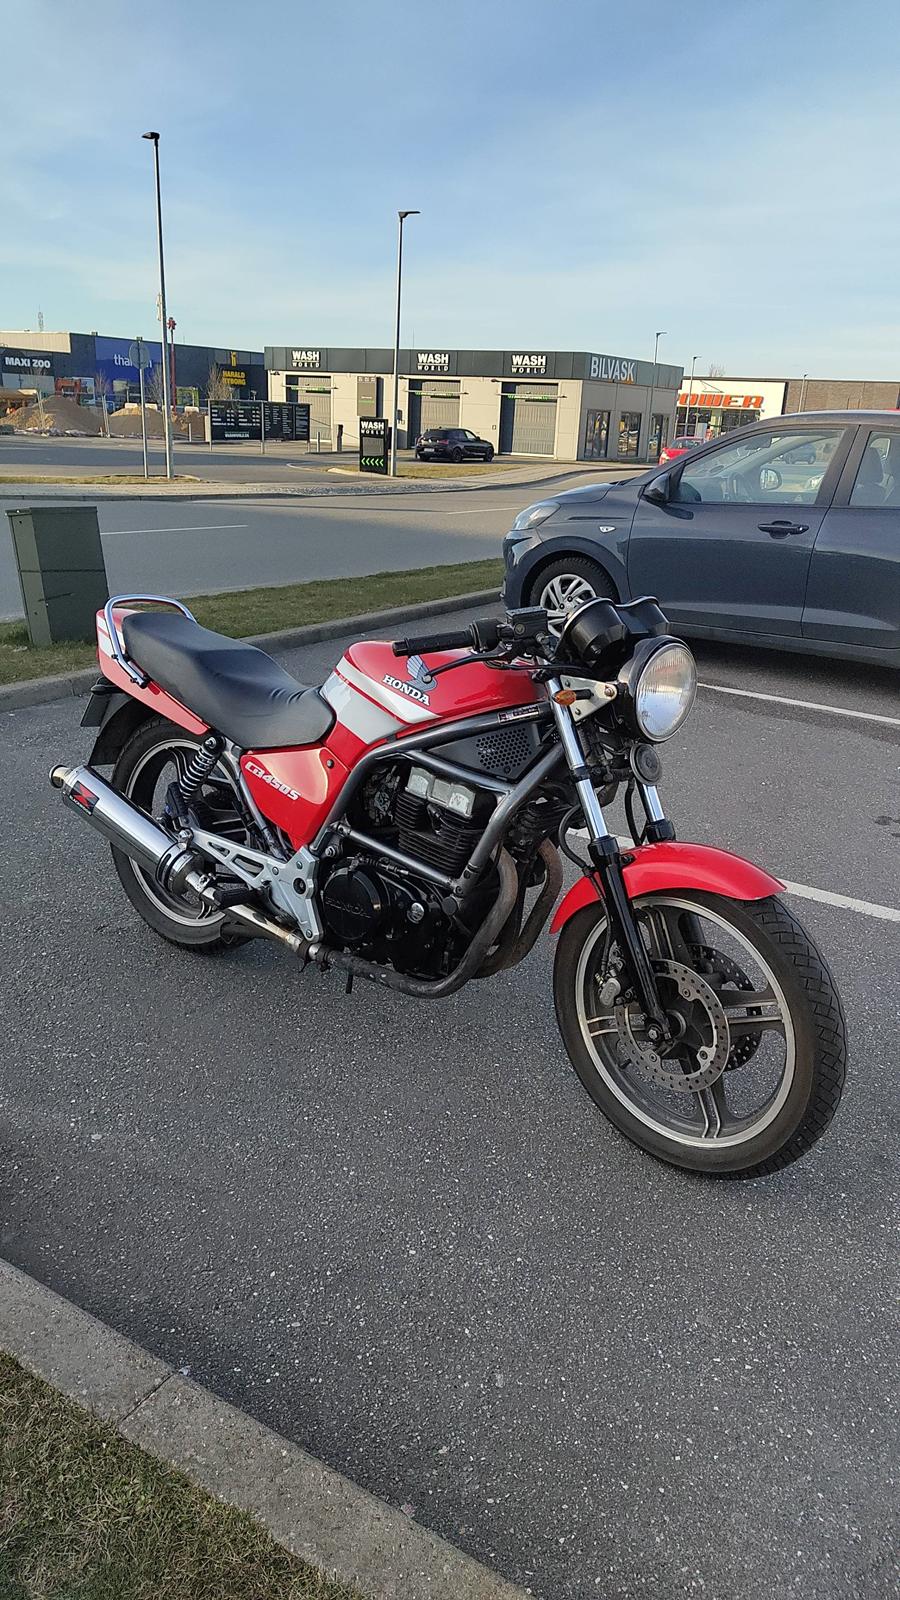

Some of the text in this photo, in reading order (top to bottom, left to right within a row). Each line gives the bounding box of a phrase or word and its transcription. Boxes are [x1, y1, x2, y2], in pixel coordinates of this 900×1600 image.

[292, 350, 320, 361] WASH
[417, 353, 449, 364] WASH
[512, 354, 546, 366] WASH
[4, 356, 51, 369] MAXI ZOO
[590, 356, 635, 382] BILVASK
[678, 393, 764, 408] OWER
[361, 420, 385, 431] WASH
[382, 674, 430, 706] HONDA
[244, 761, 302, 801] CB450S
